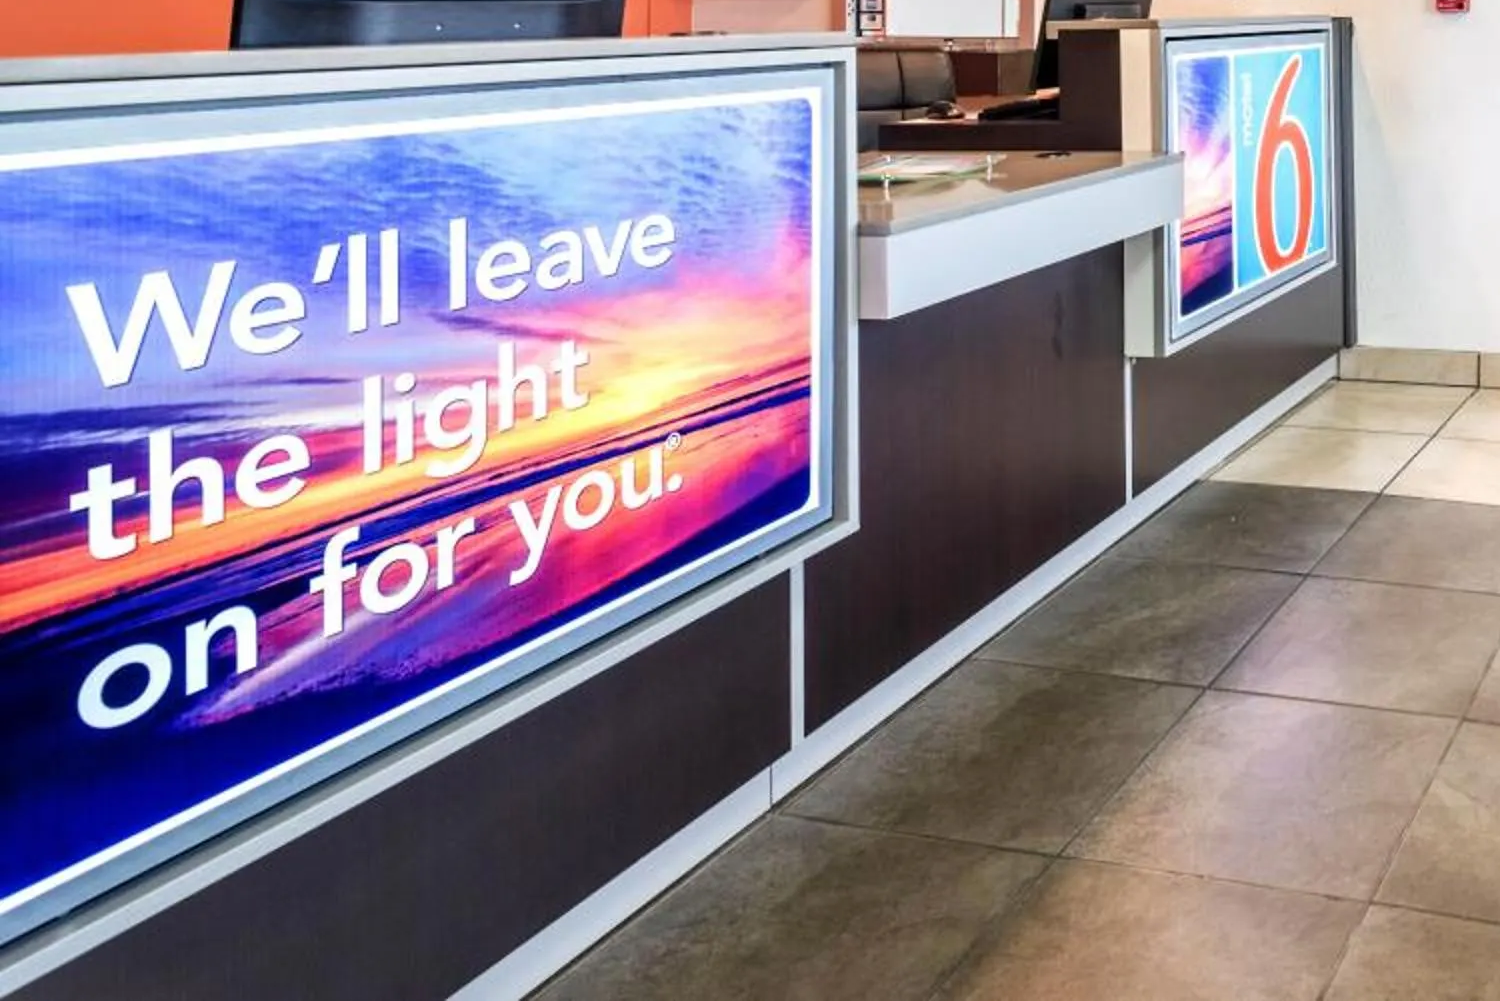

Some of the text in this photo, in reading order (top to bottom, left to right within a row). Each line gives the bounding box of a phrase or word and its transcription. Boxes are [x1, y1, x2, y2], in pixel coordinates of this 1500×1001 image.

[447, 211, 678, 312] leave
[1254, 52, 1315, 276] 6
[69, 339, 591, 561] the light
[76, 602, 260, 731] on
[309, 515, 479, 641] for
